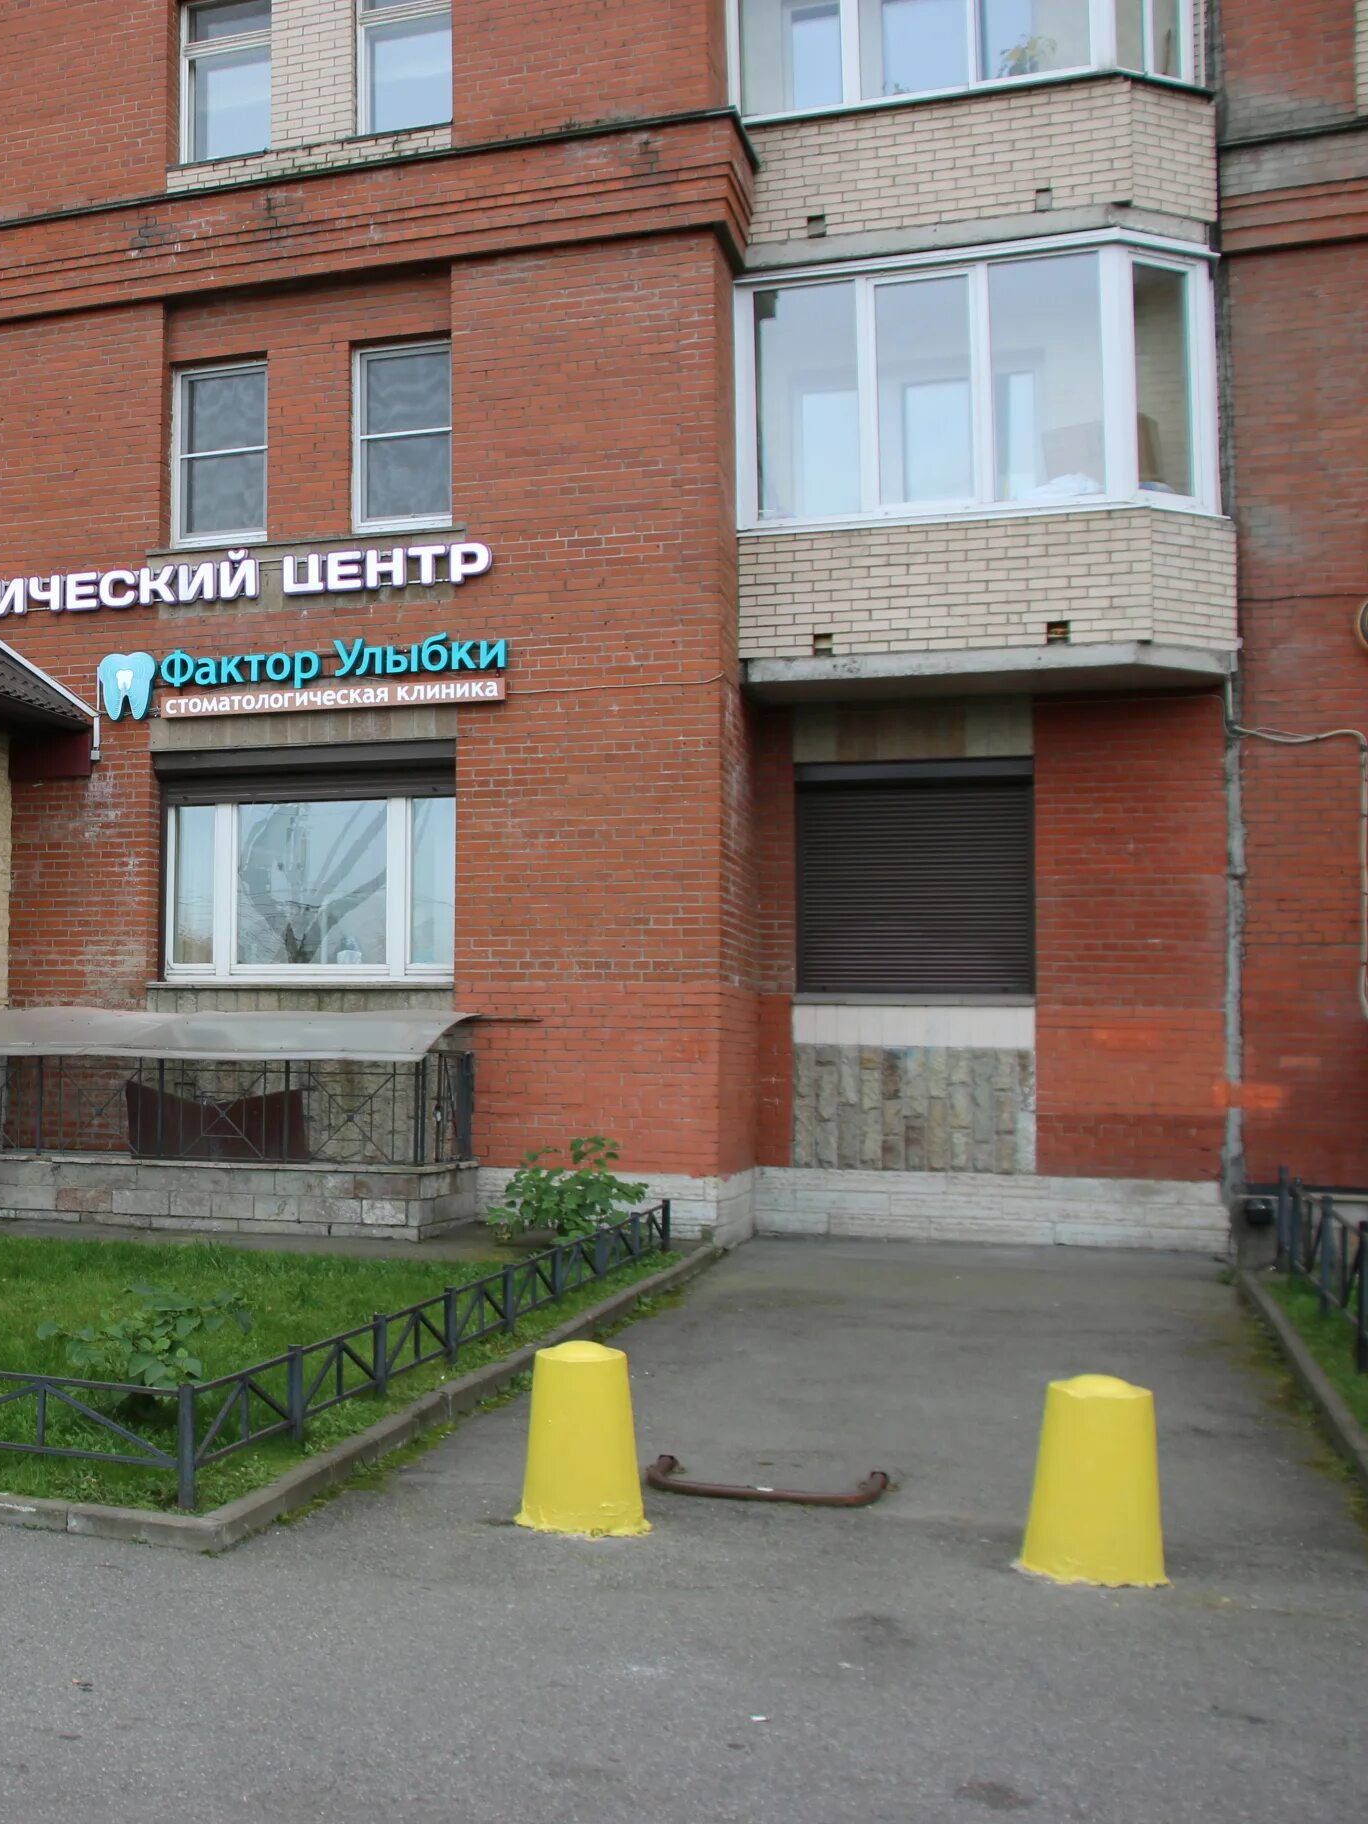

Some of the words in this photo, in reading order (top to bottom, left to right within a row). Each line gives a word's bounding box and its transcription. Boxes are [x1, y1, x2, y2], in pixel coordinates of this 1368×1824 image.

[282, 541, 492, 596] ЦЕНТР
[160, 648, 322, 689] Фактор
[333, 632, 508, 677] Улыбки
[165, 687, 389, 715] стоматологическая
[396, 681, 498, 702] клиника
